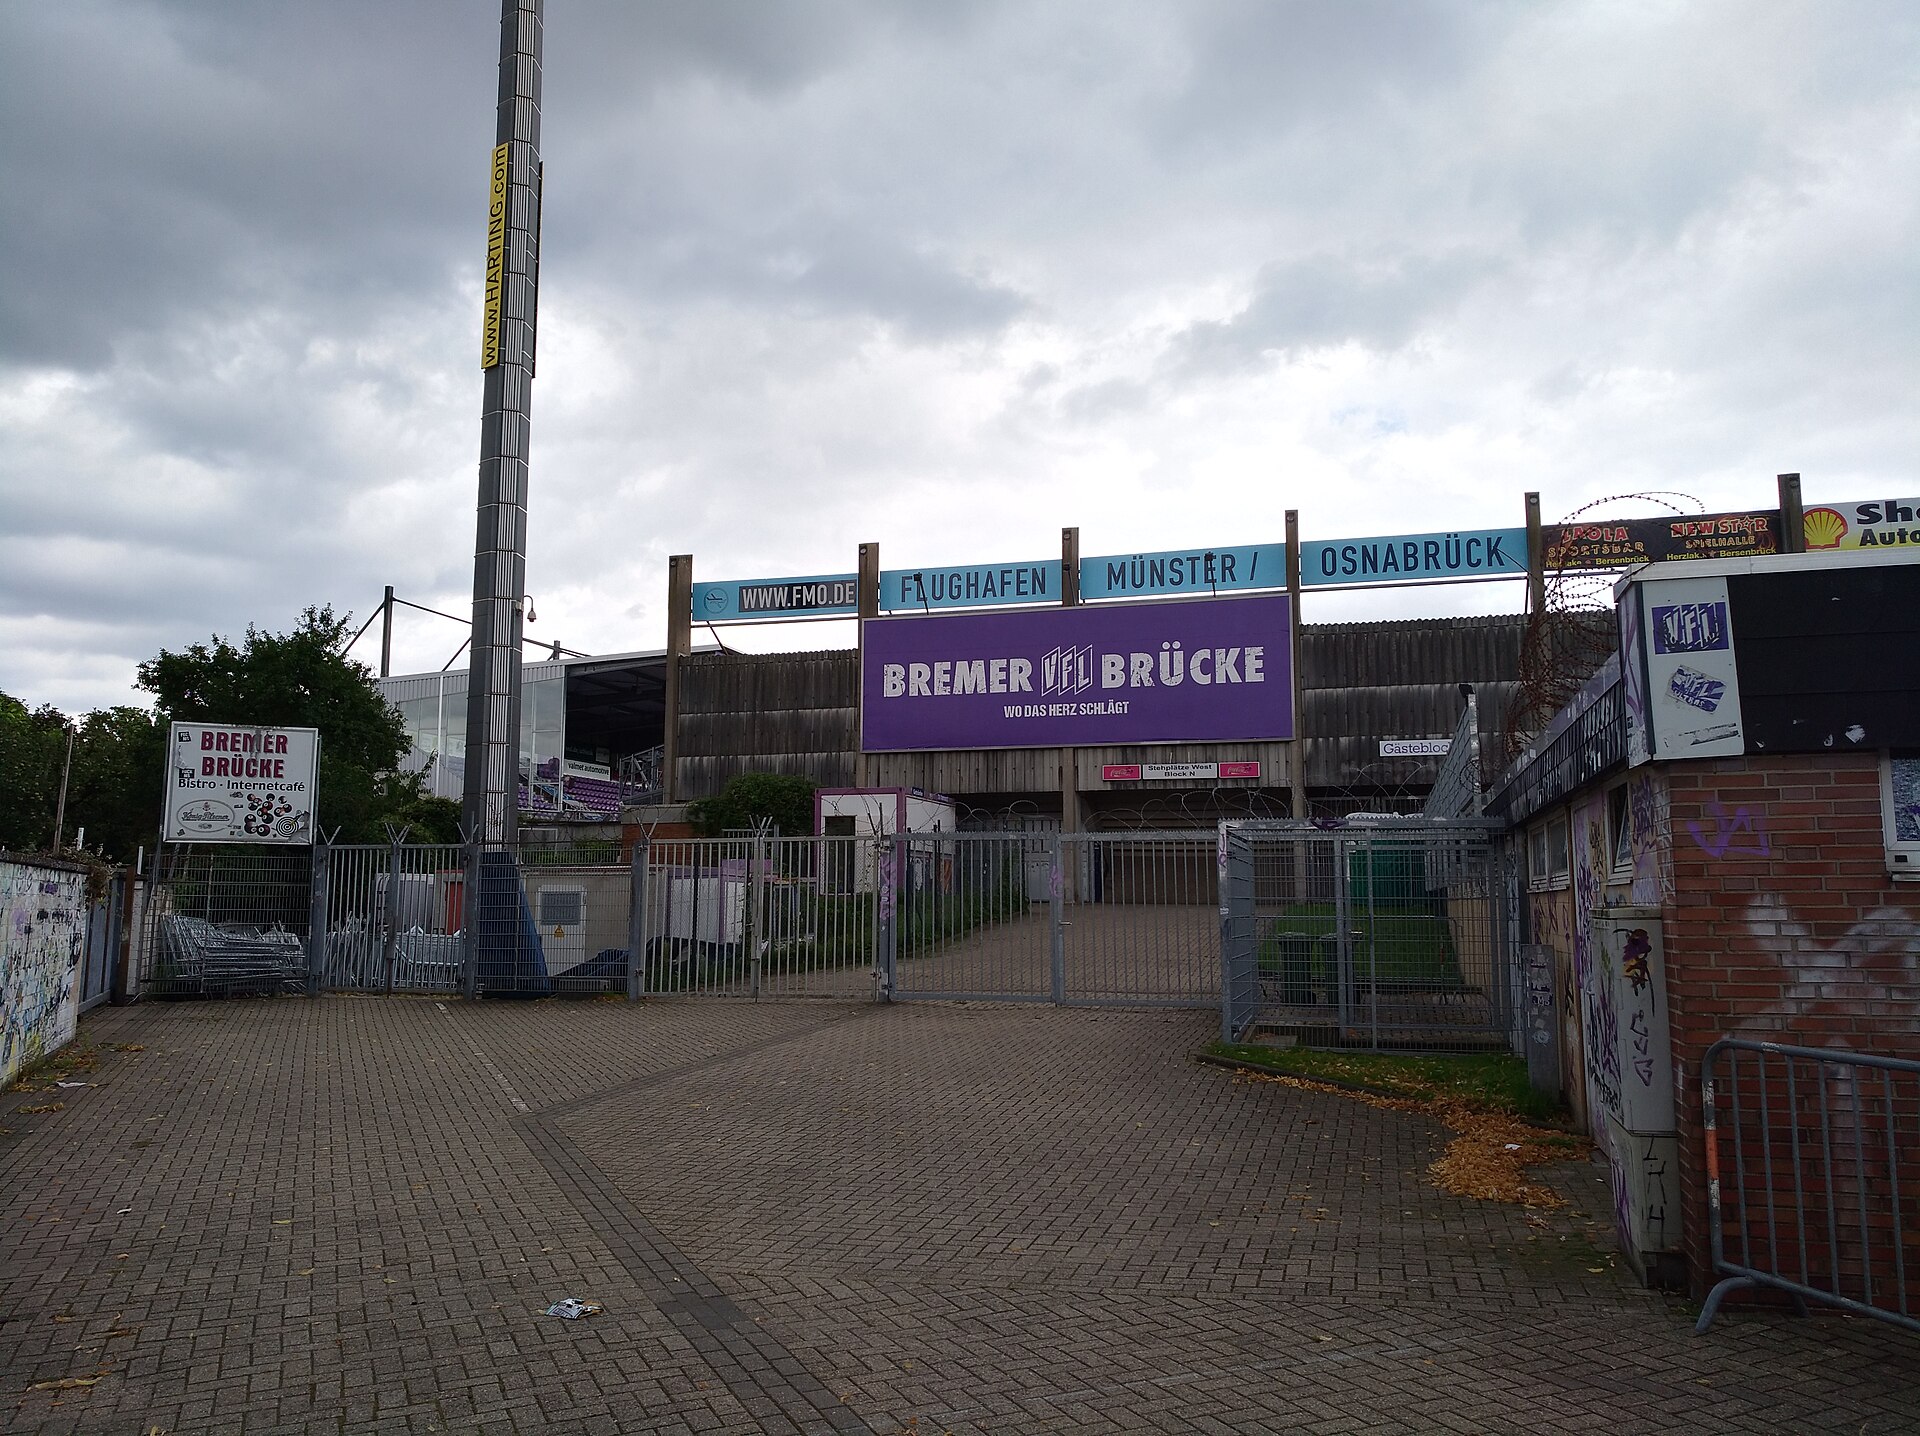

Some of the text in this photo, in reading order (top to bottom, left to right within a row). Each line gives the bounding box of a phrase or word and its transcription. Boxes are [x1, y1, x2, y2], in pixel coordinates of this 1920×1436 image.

[485, 146, 506, 365] www.HARTING.com
[1561, 526, 1629, 544] LAOLA
[1670, 521, 1715, 538] NEW
[1320, 533, 1505, 577] OSNABRÜCK
[1547, 541, 1645, 558] SPORTSBAR
[1595, 555, 1650, 565] Bersenbrück
[1720, 547, 1777, 558] Bersenbrück
[1106, 555, 1236, 590] MÜNSTER
[901, 567, 1047, 603] FLUGHAFEN
[742, 582, 856, 610] WWW.FMO.DE
[883, 657, 1034, 698] BREMER
[1101, 640, 1266, 689] BRÜCKE
[1003, 699, 1130, 718] WO DAS HERZ SCHLÄGT
[200, 731, 288, 754] BREMER
[1383, 742, 1450, 754] Gästebloc
[201, 753, 284, 779] BRÜCKE
[178, 778, 305, 792] Bistro Internetcafé
